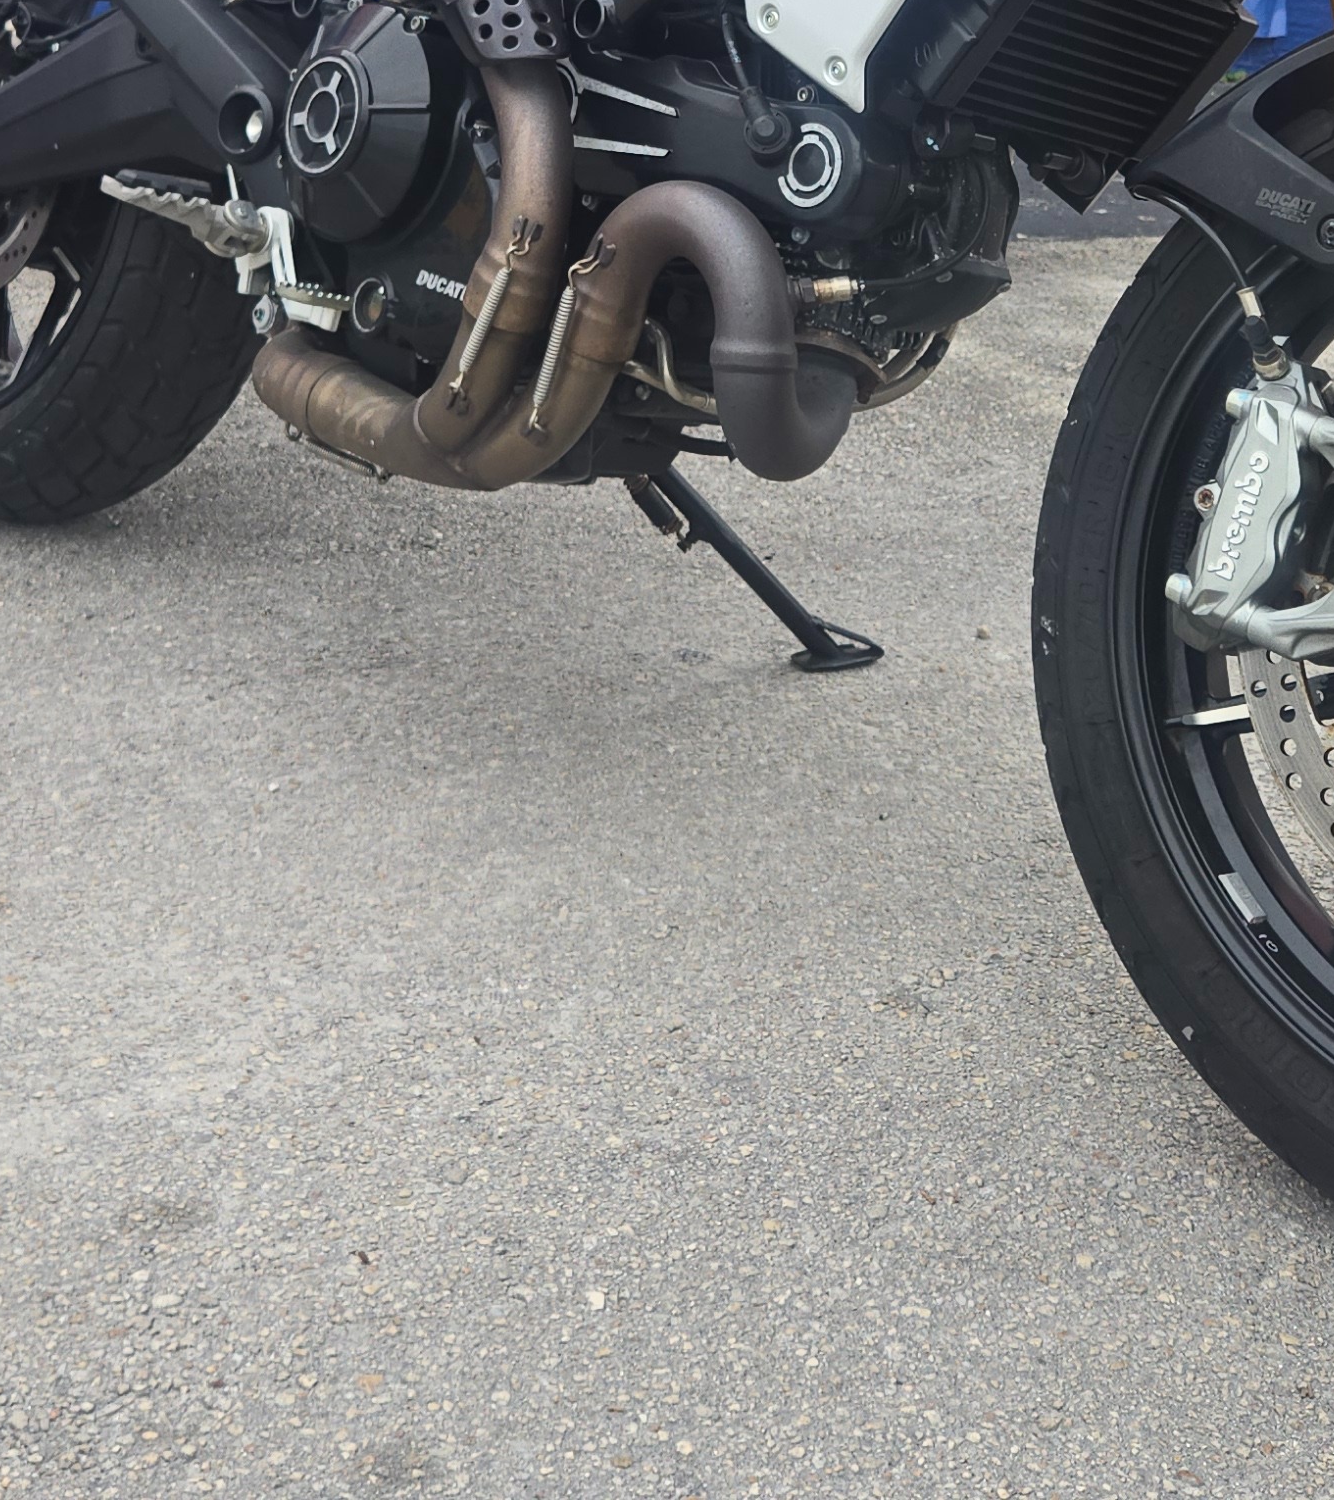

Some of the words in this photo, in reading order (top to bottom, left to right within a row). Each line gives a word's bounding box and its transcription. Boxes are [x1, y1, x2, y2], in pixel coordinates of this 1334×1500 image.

[1257, 187, 1317, 214] DUCATI
[415, 268, 467, 302] DUCATI
[1207, 450, 1269, 581] brembo
